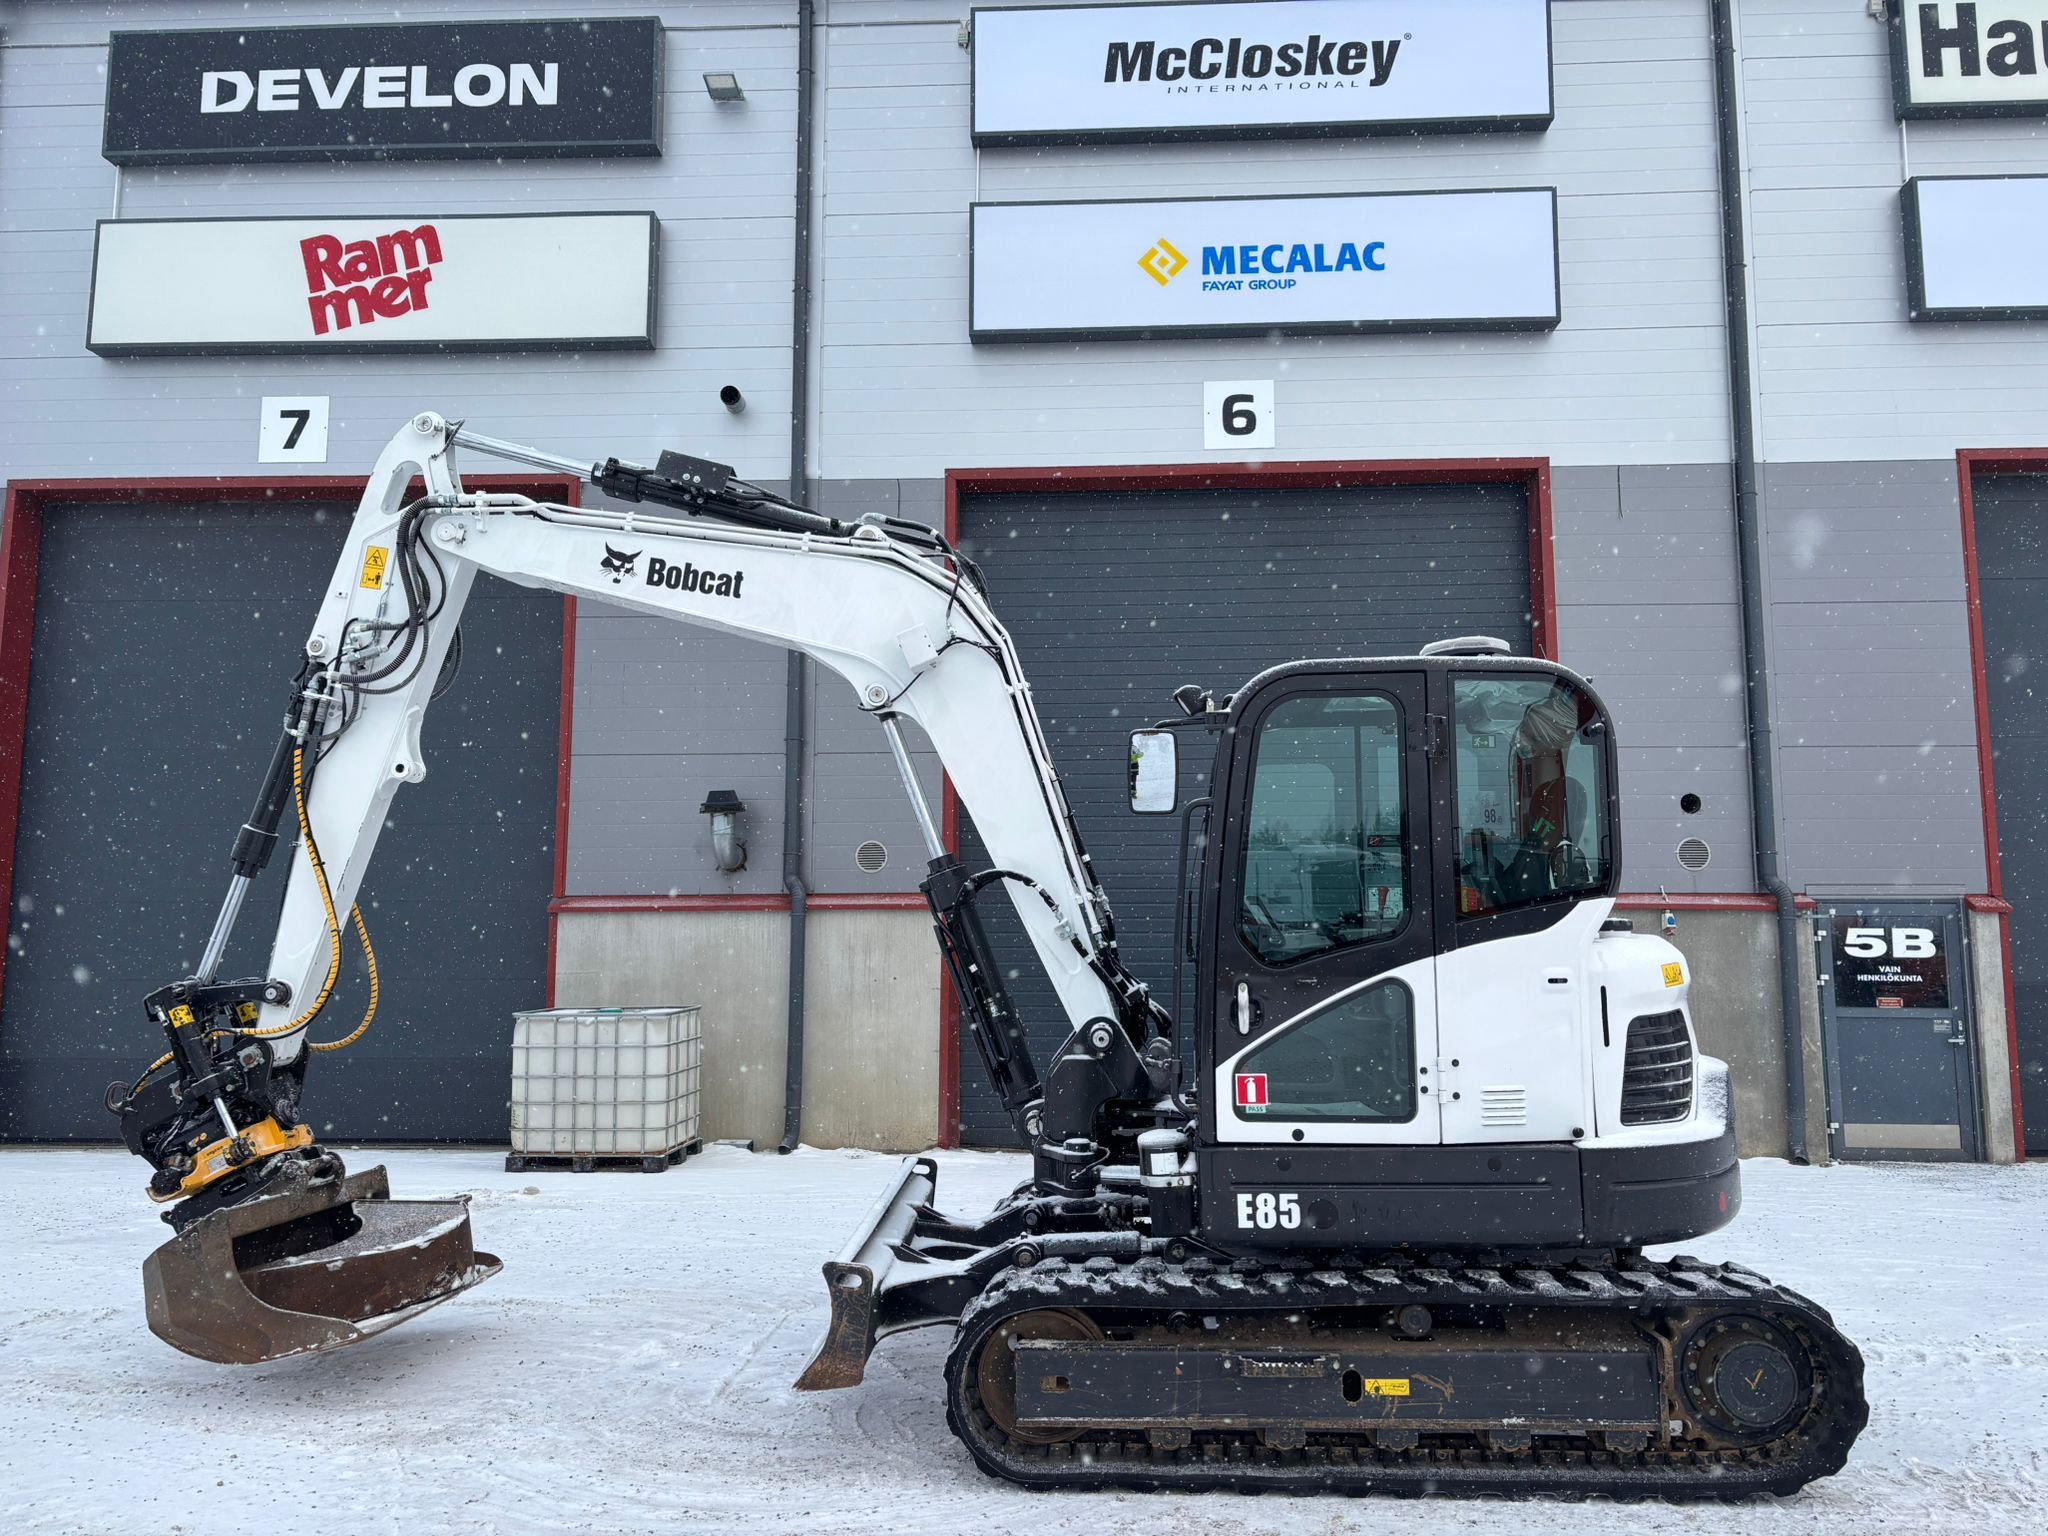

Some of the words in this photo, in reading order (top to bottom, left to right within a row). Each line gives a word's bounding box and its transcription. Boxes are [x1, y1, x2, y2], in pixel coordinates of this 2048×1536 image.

[1918, 2, 2048, 77] Ha
[200, 62, 559, 114] DEVELON
[1166, 80, 1359, 95] INTERNATIONAL
[300, 225, 443, 294] Ram
[1201, 241, 1386, 276] MECALAC
[308, 268, 433, 336] mer
[1202, 280, 1243, 292] FAYAT
[1249, 278, 1297, 291] GROUP
[280, 409, 310, 450] 7
[1222, 394, 1257, 436] 6
[646, 557, 744, 599] Bobcat
[1844, 927, 1937, 959] 5B
[1857, 973, 1923, 983] HENKILÖKUNTA
[1879, 965, 1901, 973] VAIN
[1236, 1192, 1302, 1230] E85
